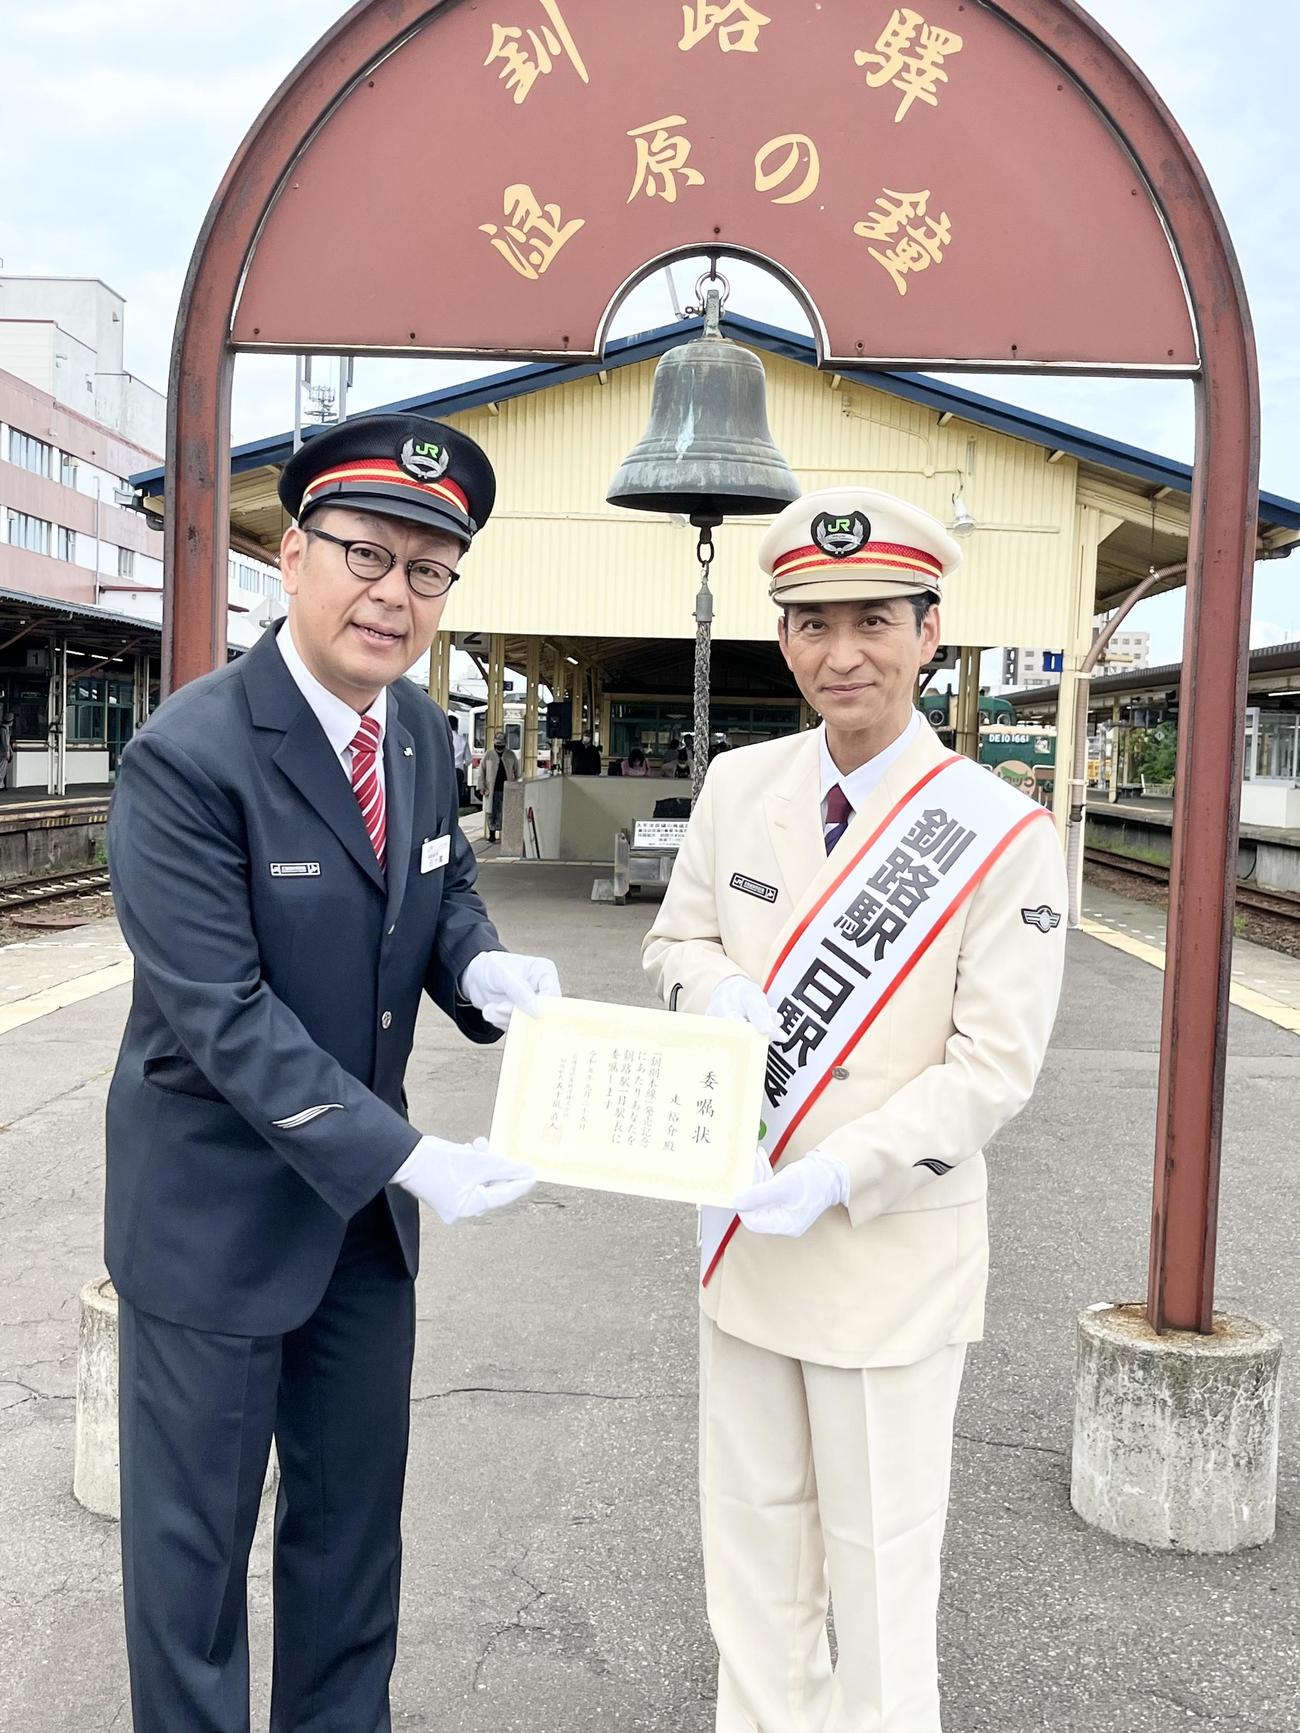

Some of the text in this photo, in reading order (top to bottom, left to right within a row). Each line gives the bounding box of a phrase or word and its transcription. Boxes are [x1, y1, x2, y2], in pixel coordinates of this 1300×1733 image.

[416, 443, 439, 458] JR
[828, 519, 850, 532] JR
[692, 1071, 719, 1144] 委嘱状
